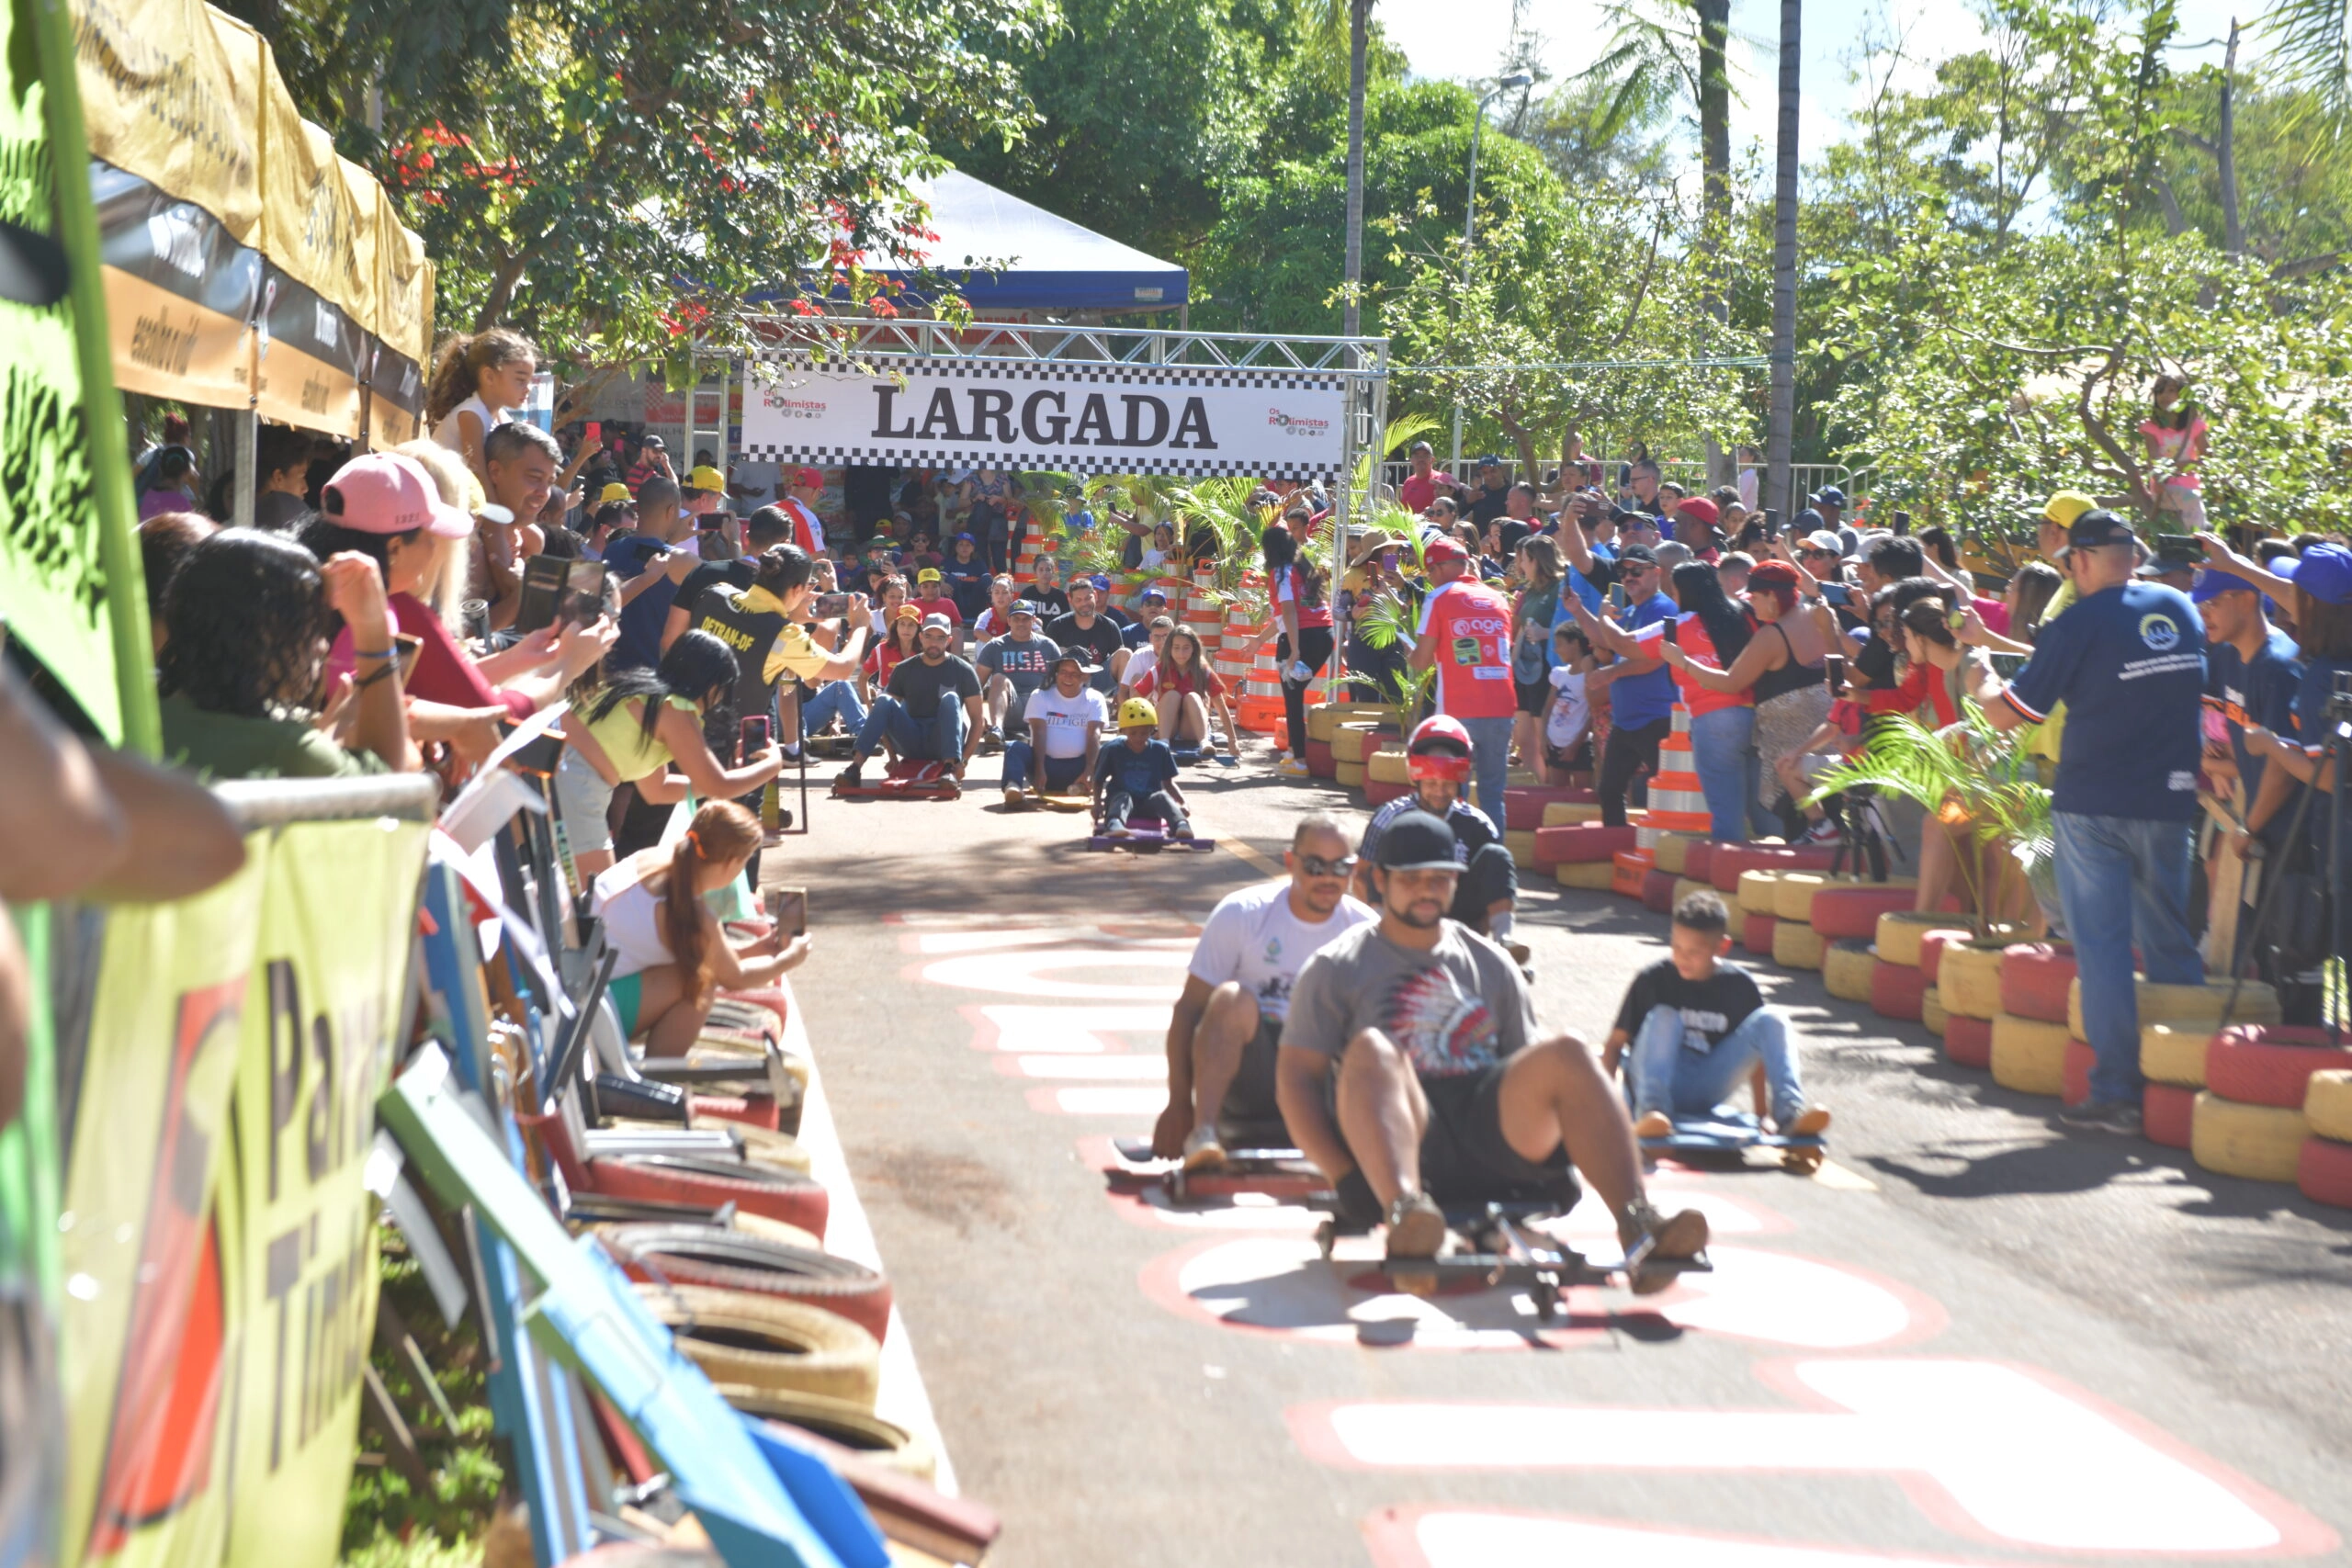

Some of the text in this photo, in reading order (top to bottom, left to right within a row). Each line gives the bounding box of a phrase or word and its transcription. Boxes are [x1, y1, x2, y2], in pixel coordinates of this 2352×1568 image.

[870, 384, 1218, 451] LARGADA
[1269, 407, 1280, 415] Os
[701, 615, 755, 652] DETRAN-DF
[1001, 650, 1046, 673] USA
